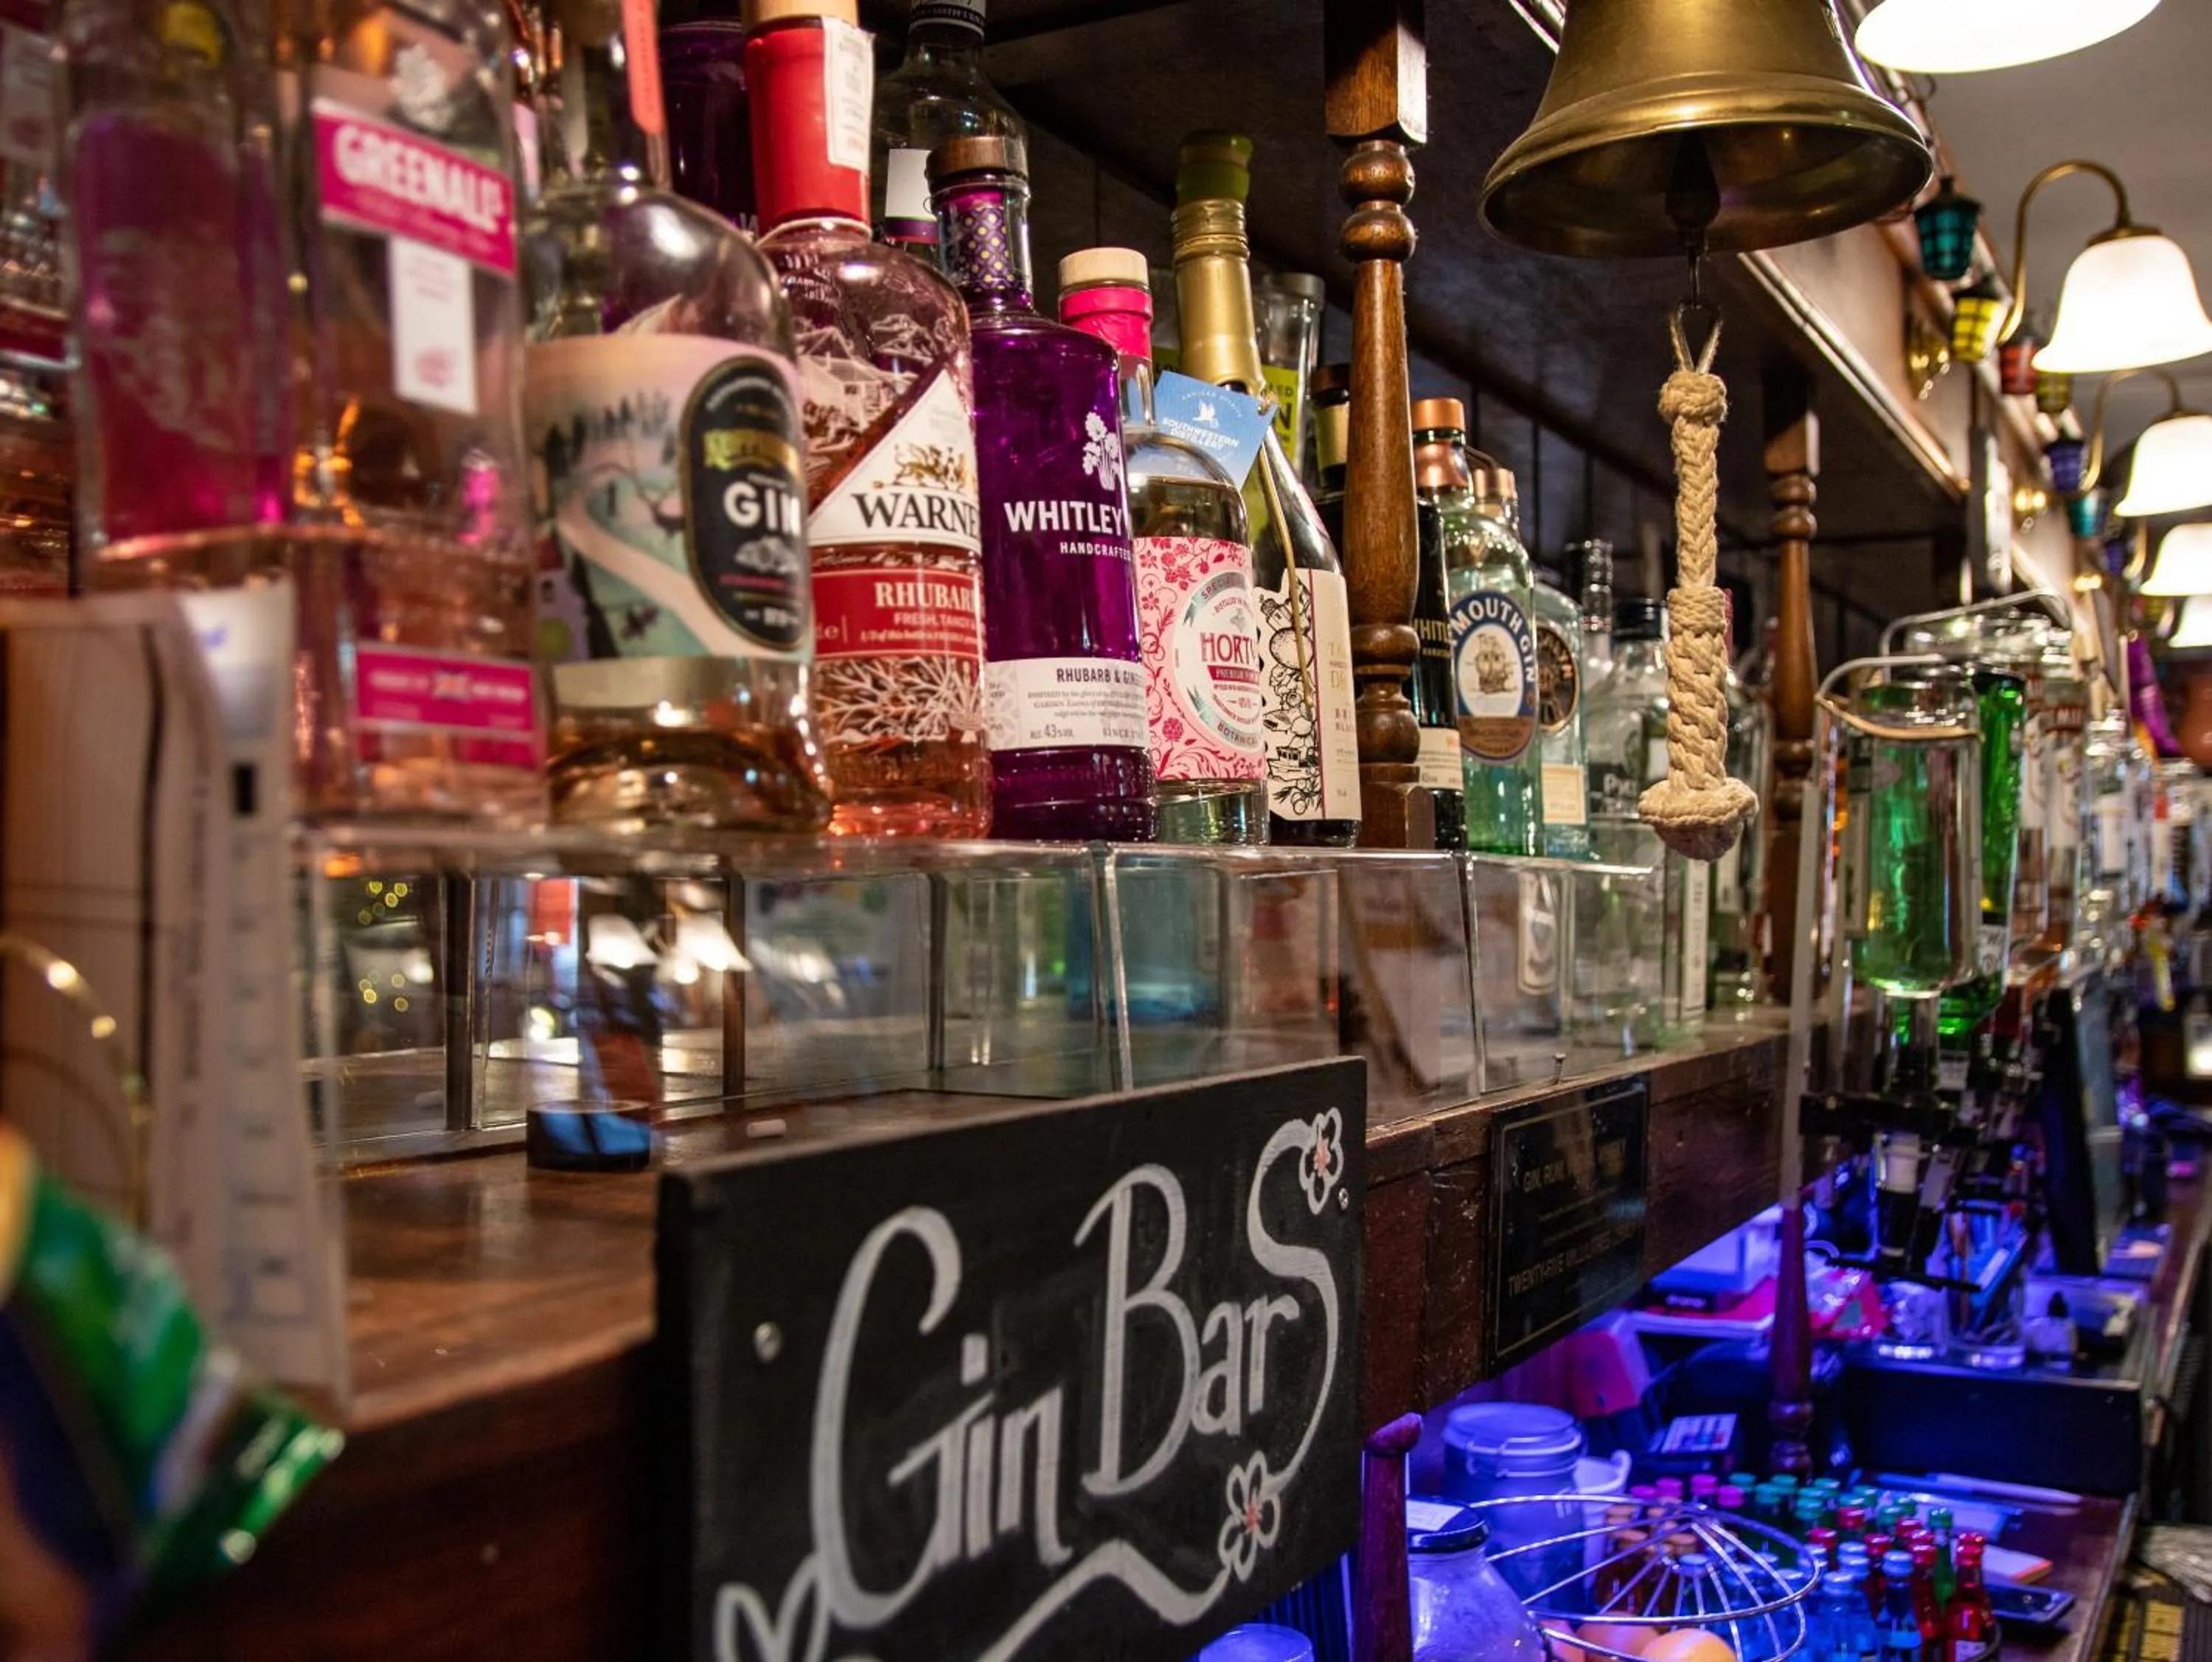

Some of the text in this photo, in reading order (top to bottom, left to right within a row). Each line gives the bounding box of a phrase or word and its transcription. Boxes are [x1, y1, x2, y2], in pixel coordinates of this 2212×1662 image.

[1004, 501, 1122, 536] WHITLEY
[1449, 598, 1523, 646] MOUTH
[1519, 634, 1536, 682] GIN
[1057, 668, 1112, 684] RHUBARB
[1114, 670, 1121, 683] &
[810, 1205, 1074, 1629] Gin
